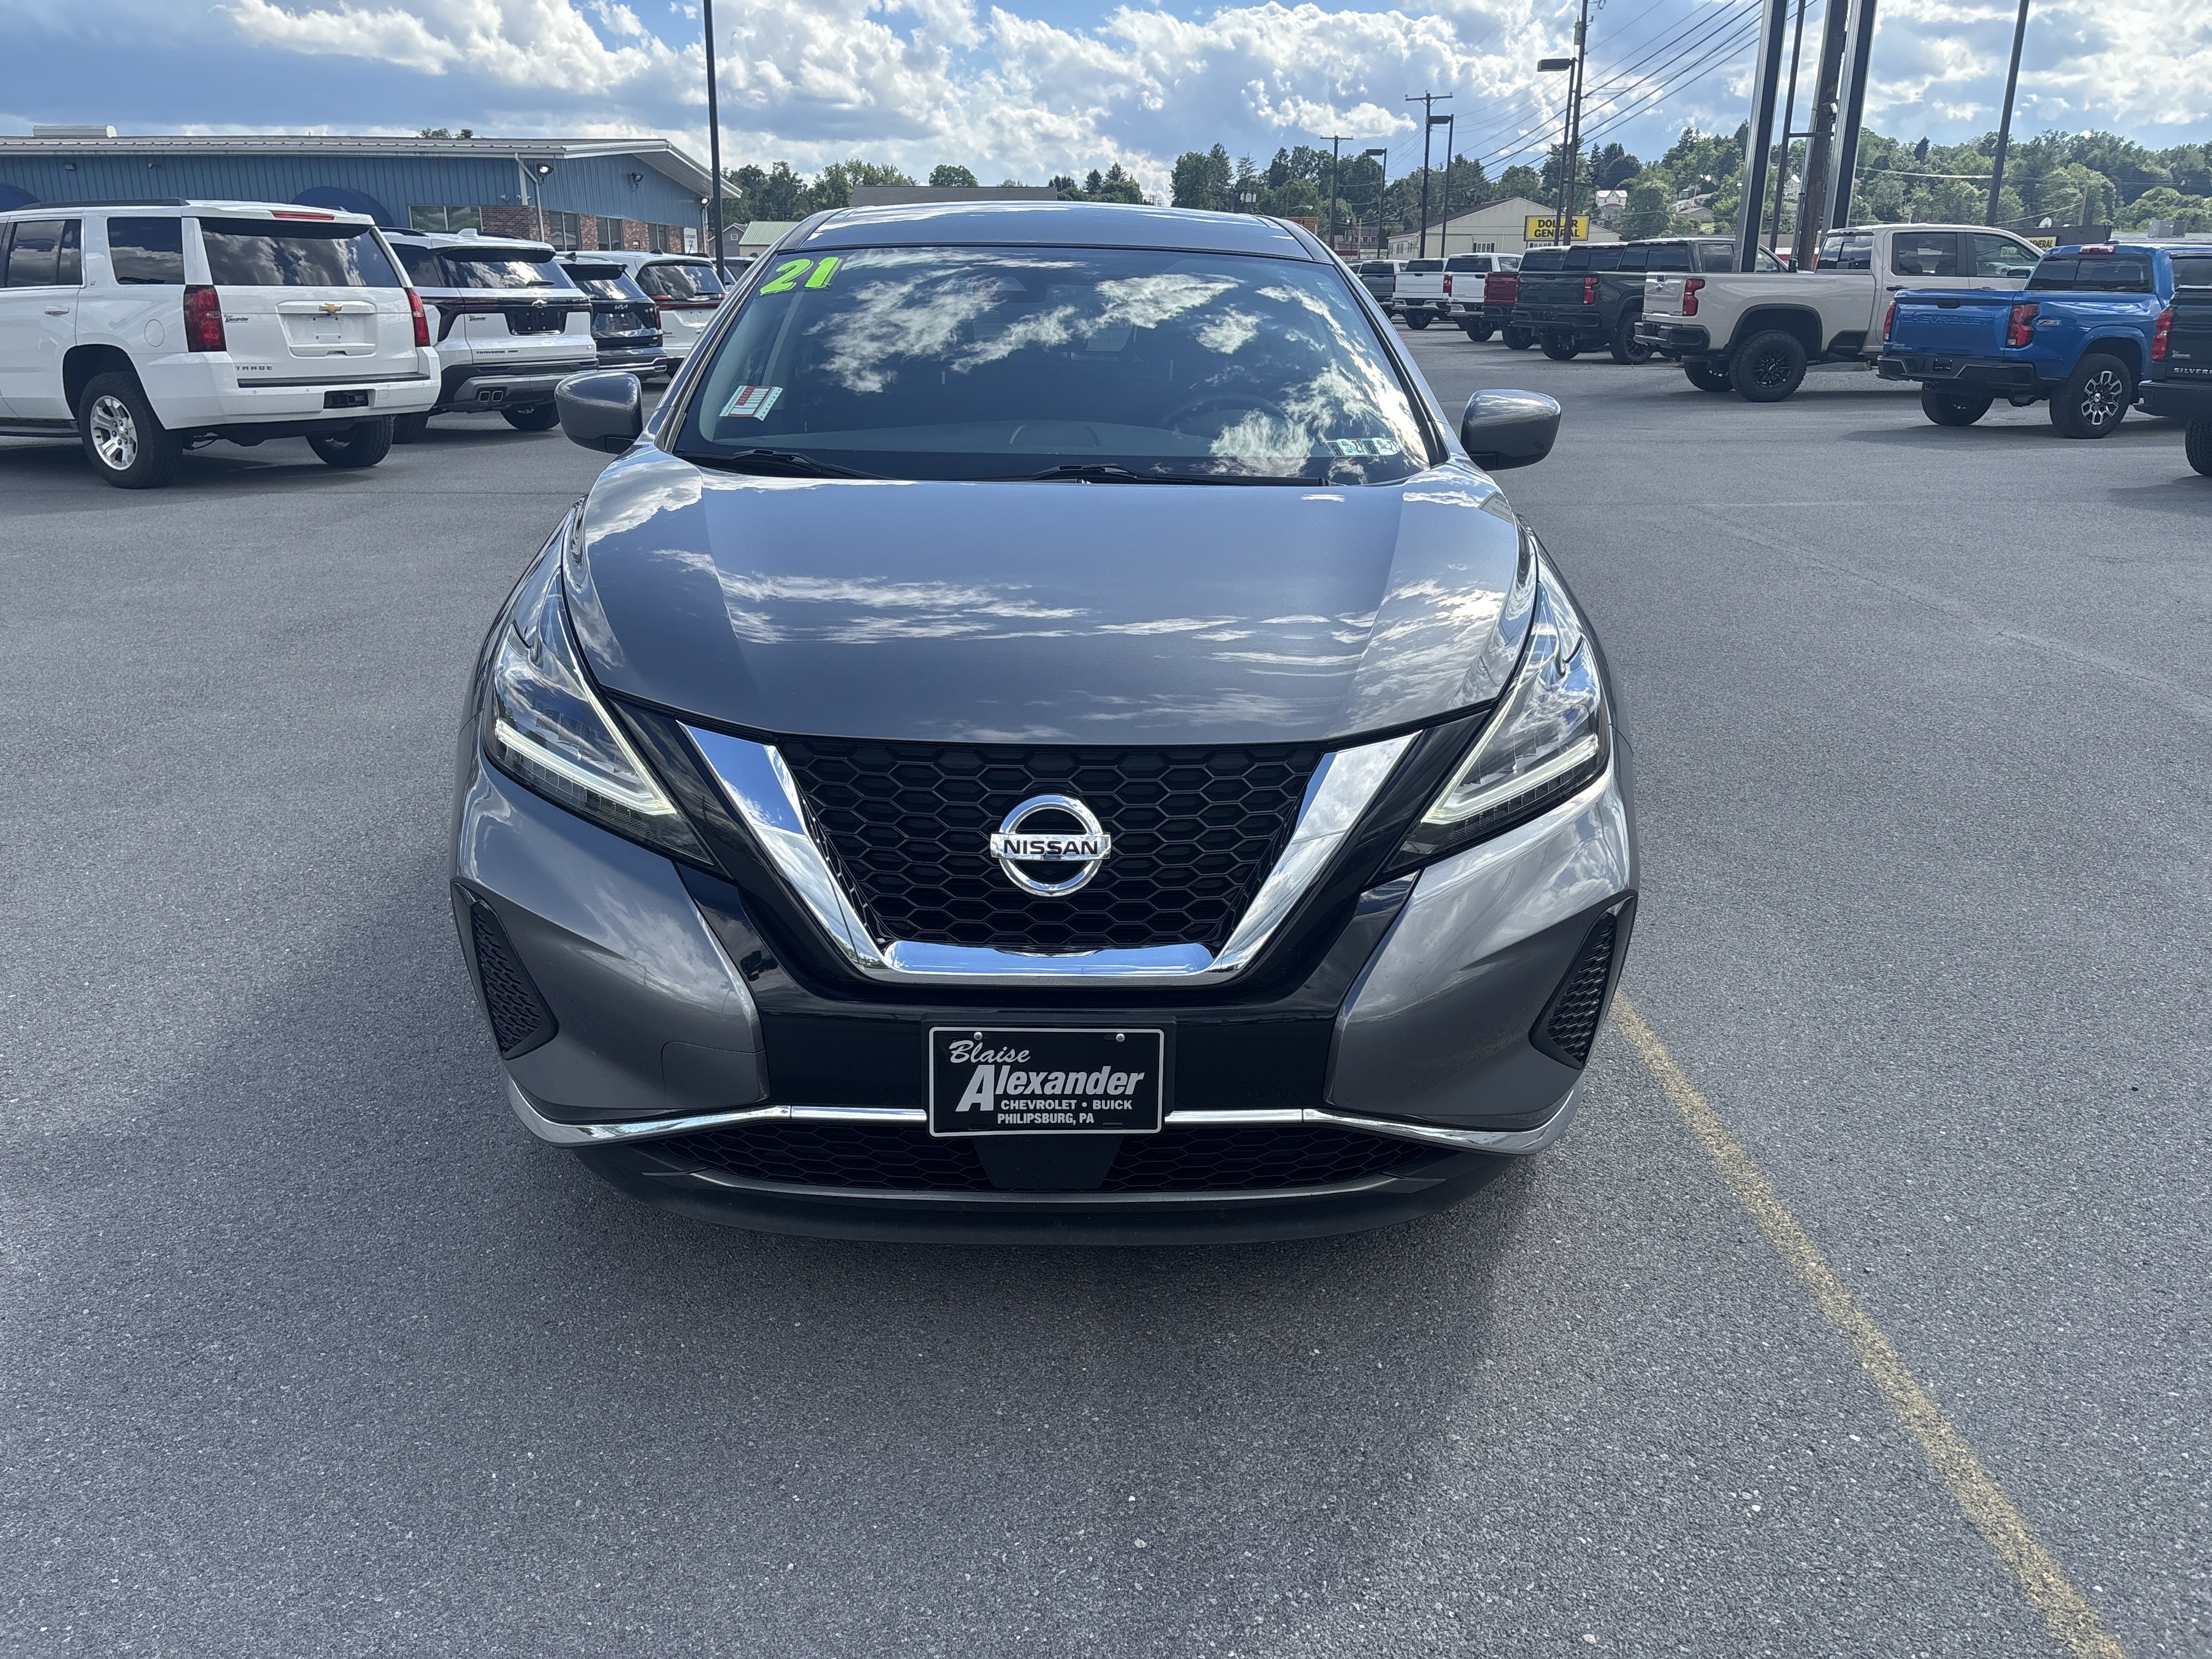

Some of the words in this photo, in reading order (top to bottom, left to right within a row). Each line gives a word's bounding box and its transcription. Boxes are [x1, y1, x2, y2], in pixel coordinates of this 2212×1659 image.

[760, 257, 843, 295] 21
[1004, 839, 1098, 855] NISSAN
[949, 1040, 1030, 1063] Blaise
[955, 1064, 1145, 1112] Alexander
[1001, 1099, 1077, 1110] CHEVROLET
[1092, 1099, 1133, 1110] BUICK
[997, 1113, 1077, 1125] PHILIPSBURG,
[1079, 1113, 1094, 1124] PA
